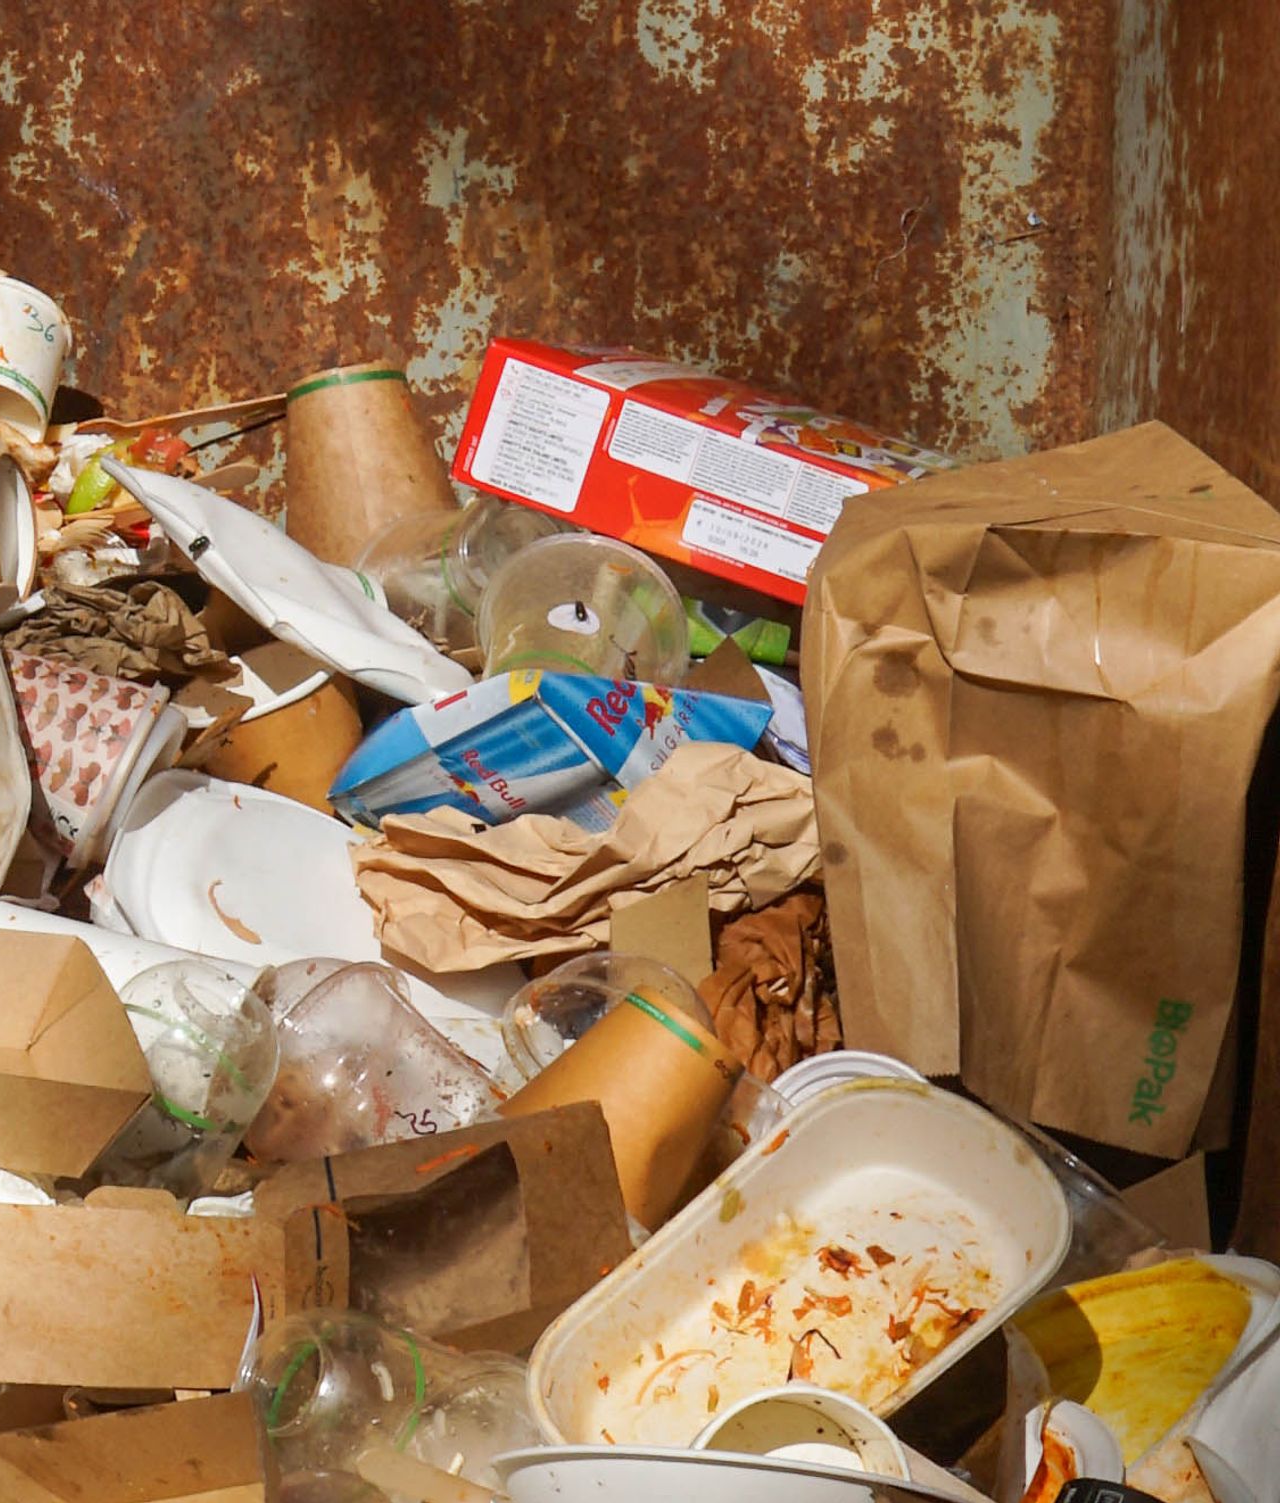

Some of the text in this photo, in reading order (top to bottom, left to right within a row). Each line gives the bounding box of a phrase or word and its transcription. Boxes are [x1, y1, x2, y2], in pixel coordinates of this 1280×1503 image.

[460, 748, 526, 811] Red Bull
[1127, 998, 1195, 1127] BioPak
